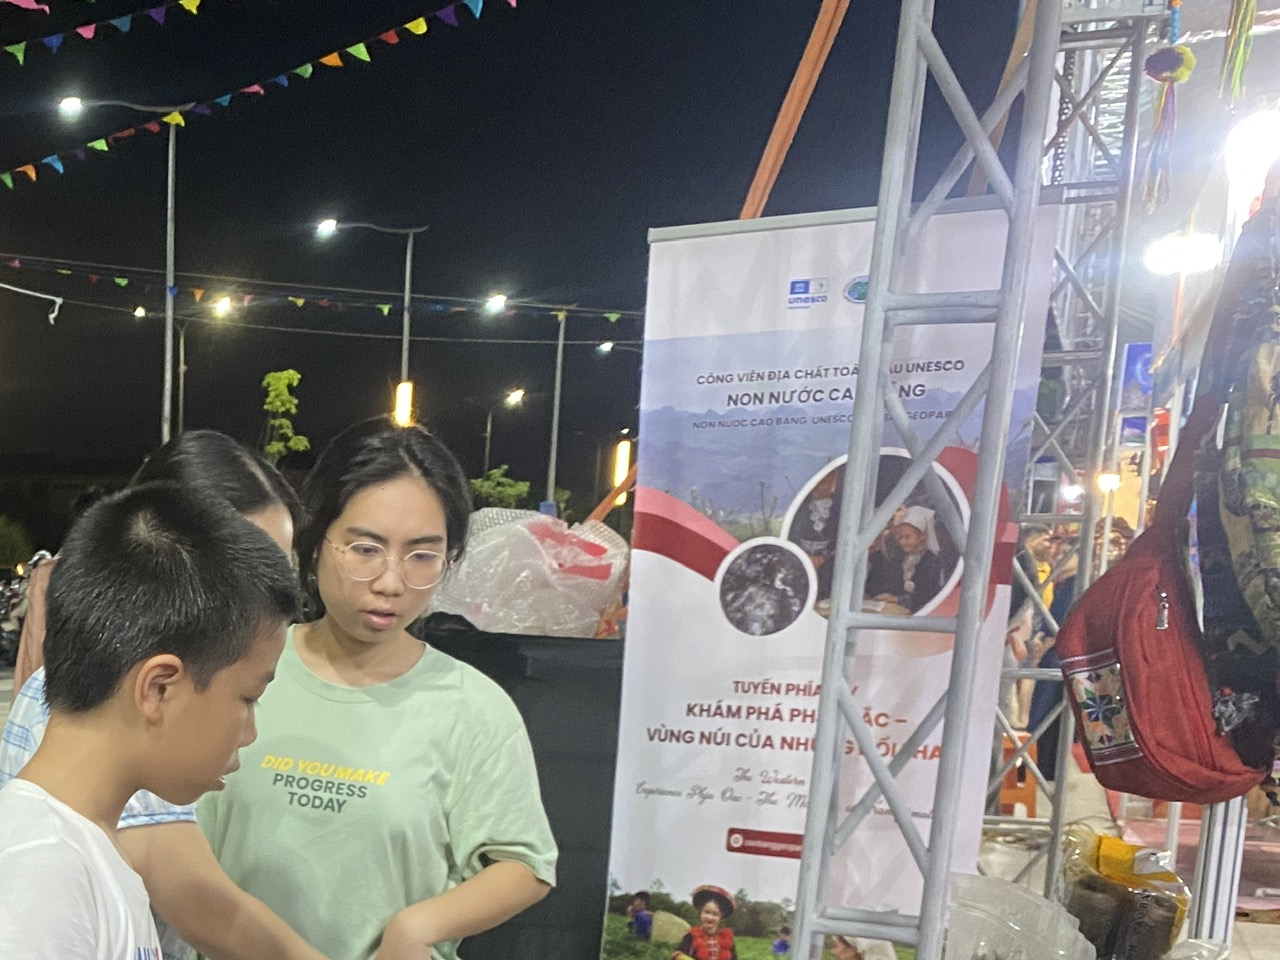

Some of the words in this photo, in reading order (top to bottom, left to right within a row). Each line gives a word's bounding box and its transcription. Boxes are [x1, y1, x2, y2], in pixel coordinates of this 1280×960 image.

[788, 294, 829, 305] unesco
[696, 370, 735, 386] CÔNG
[735, 368, 765, 383] VIÊN
[767, 369, 791, 384] ĐỊA
[794, 363, 831, 381] CHẤT
[833, 363, 859, 378] TOÀ
[904, 359, 965, 374] UNESCO
[726, 391, 765, 408] NON
[769, 386, 825, 406] NƯỚC
[828, 387, 854, 402] CA
[907, 409, 953, 421] GEOPAR
[732, 677, 781, 695] TUYẾN
[785, 680, 822, 697] PHÍA
[685, 699, 743, 719] KHÁM
[745, 702, 785, 723] PHÁ
[862, 705, 891, 728] ẮC
[646, 723, 696, 744] VÙNG
[699, 726, 731, 747] NÚI
[734, 729, 775, 750] CỦA
[260, 754, 295, 772] DID
[297, 758, 335, 777] YOU
[334, 765, 391, 786] MAKE
[272, 773, 368, 799] PROGRESS
[287, 791, 347, 813] TODAY
